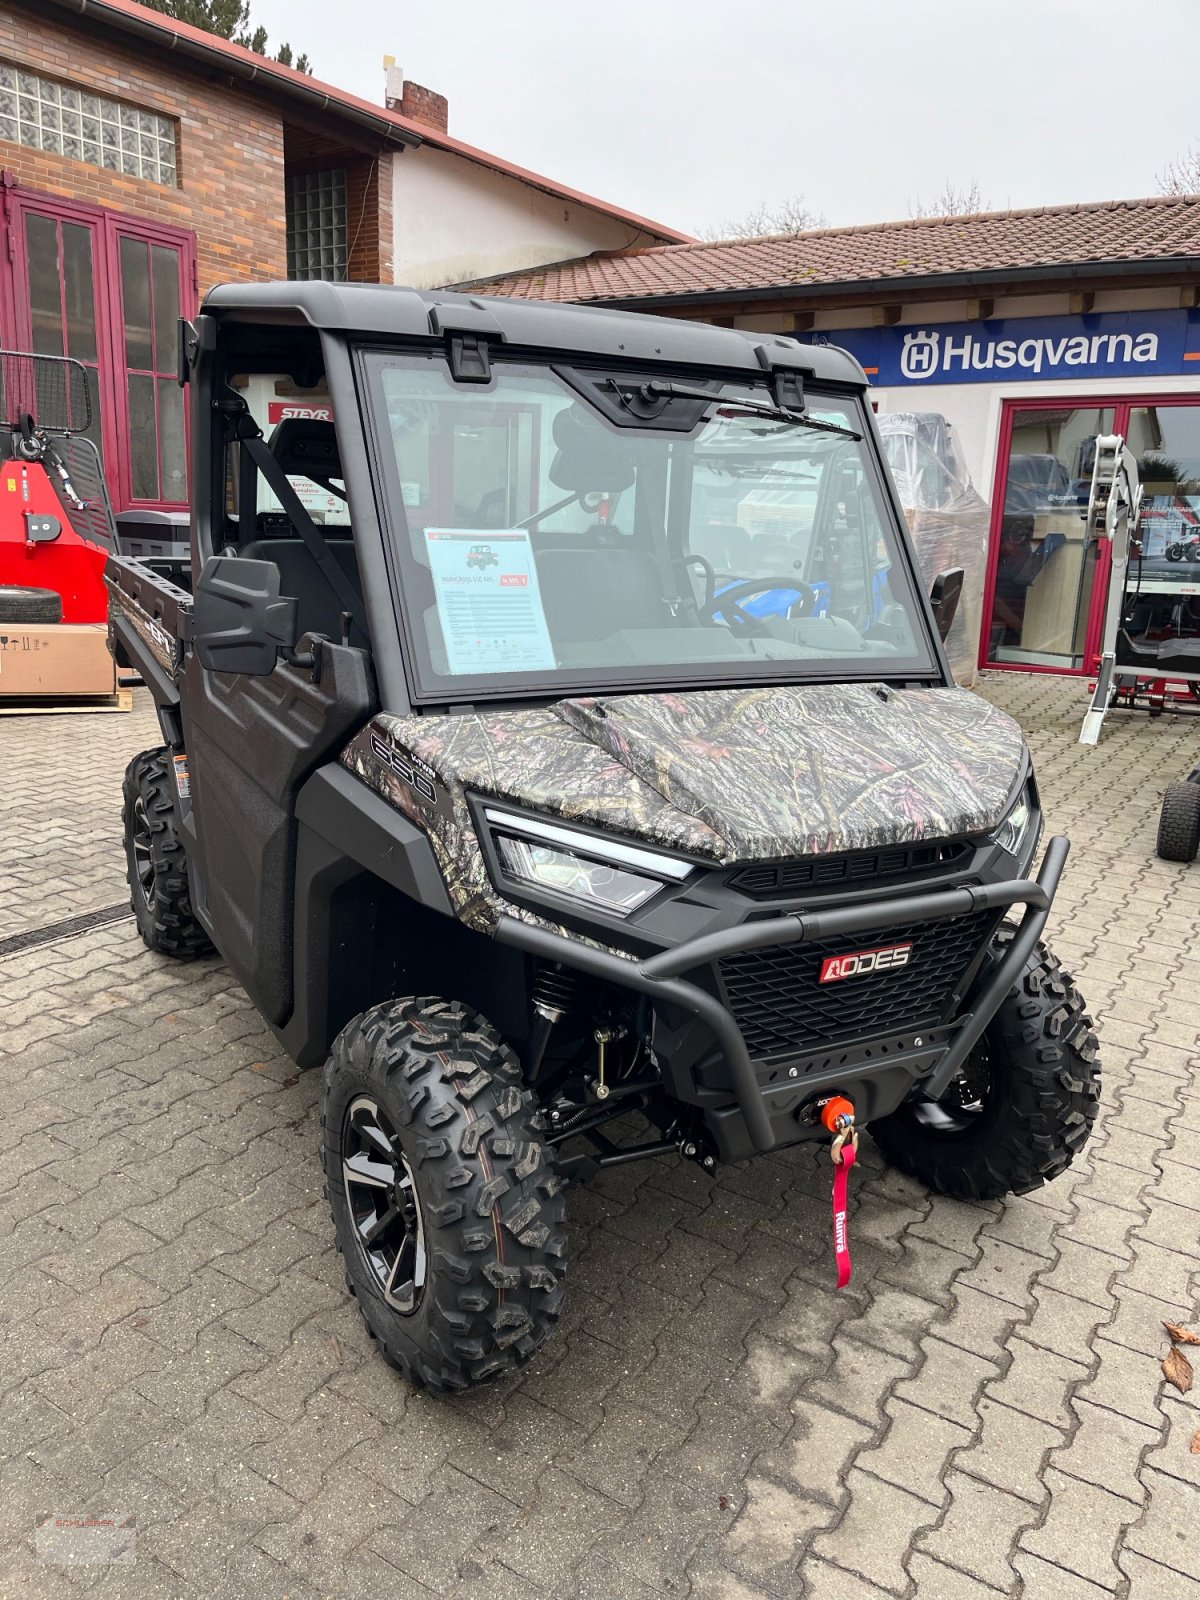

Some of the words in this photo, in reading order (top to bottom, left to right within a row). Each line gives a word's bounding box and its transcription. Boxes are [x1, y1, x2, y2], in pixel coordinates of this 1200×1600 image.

[942, 332, 1159, 373] Husqvarna
[281, 407, 330, 420] STEYR
[371, 732, 438, 804] 650
[410, 752, 436, 779] V-TWIN
[823, 946, 911, 981] AODES
[835, 1210, 846, 1253] Runva
